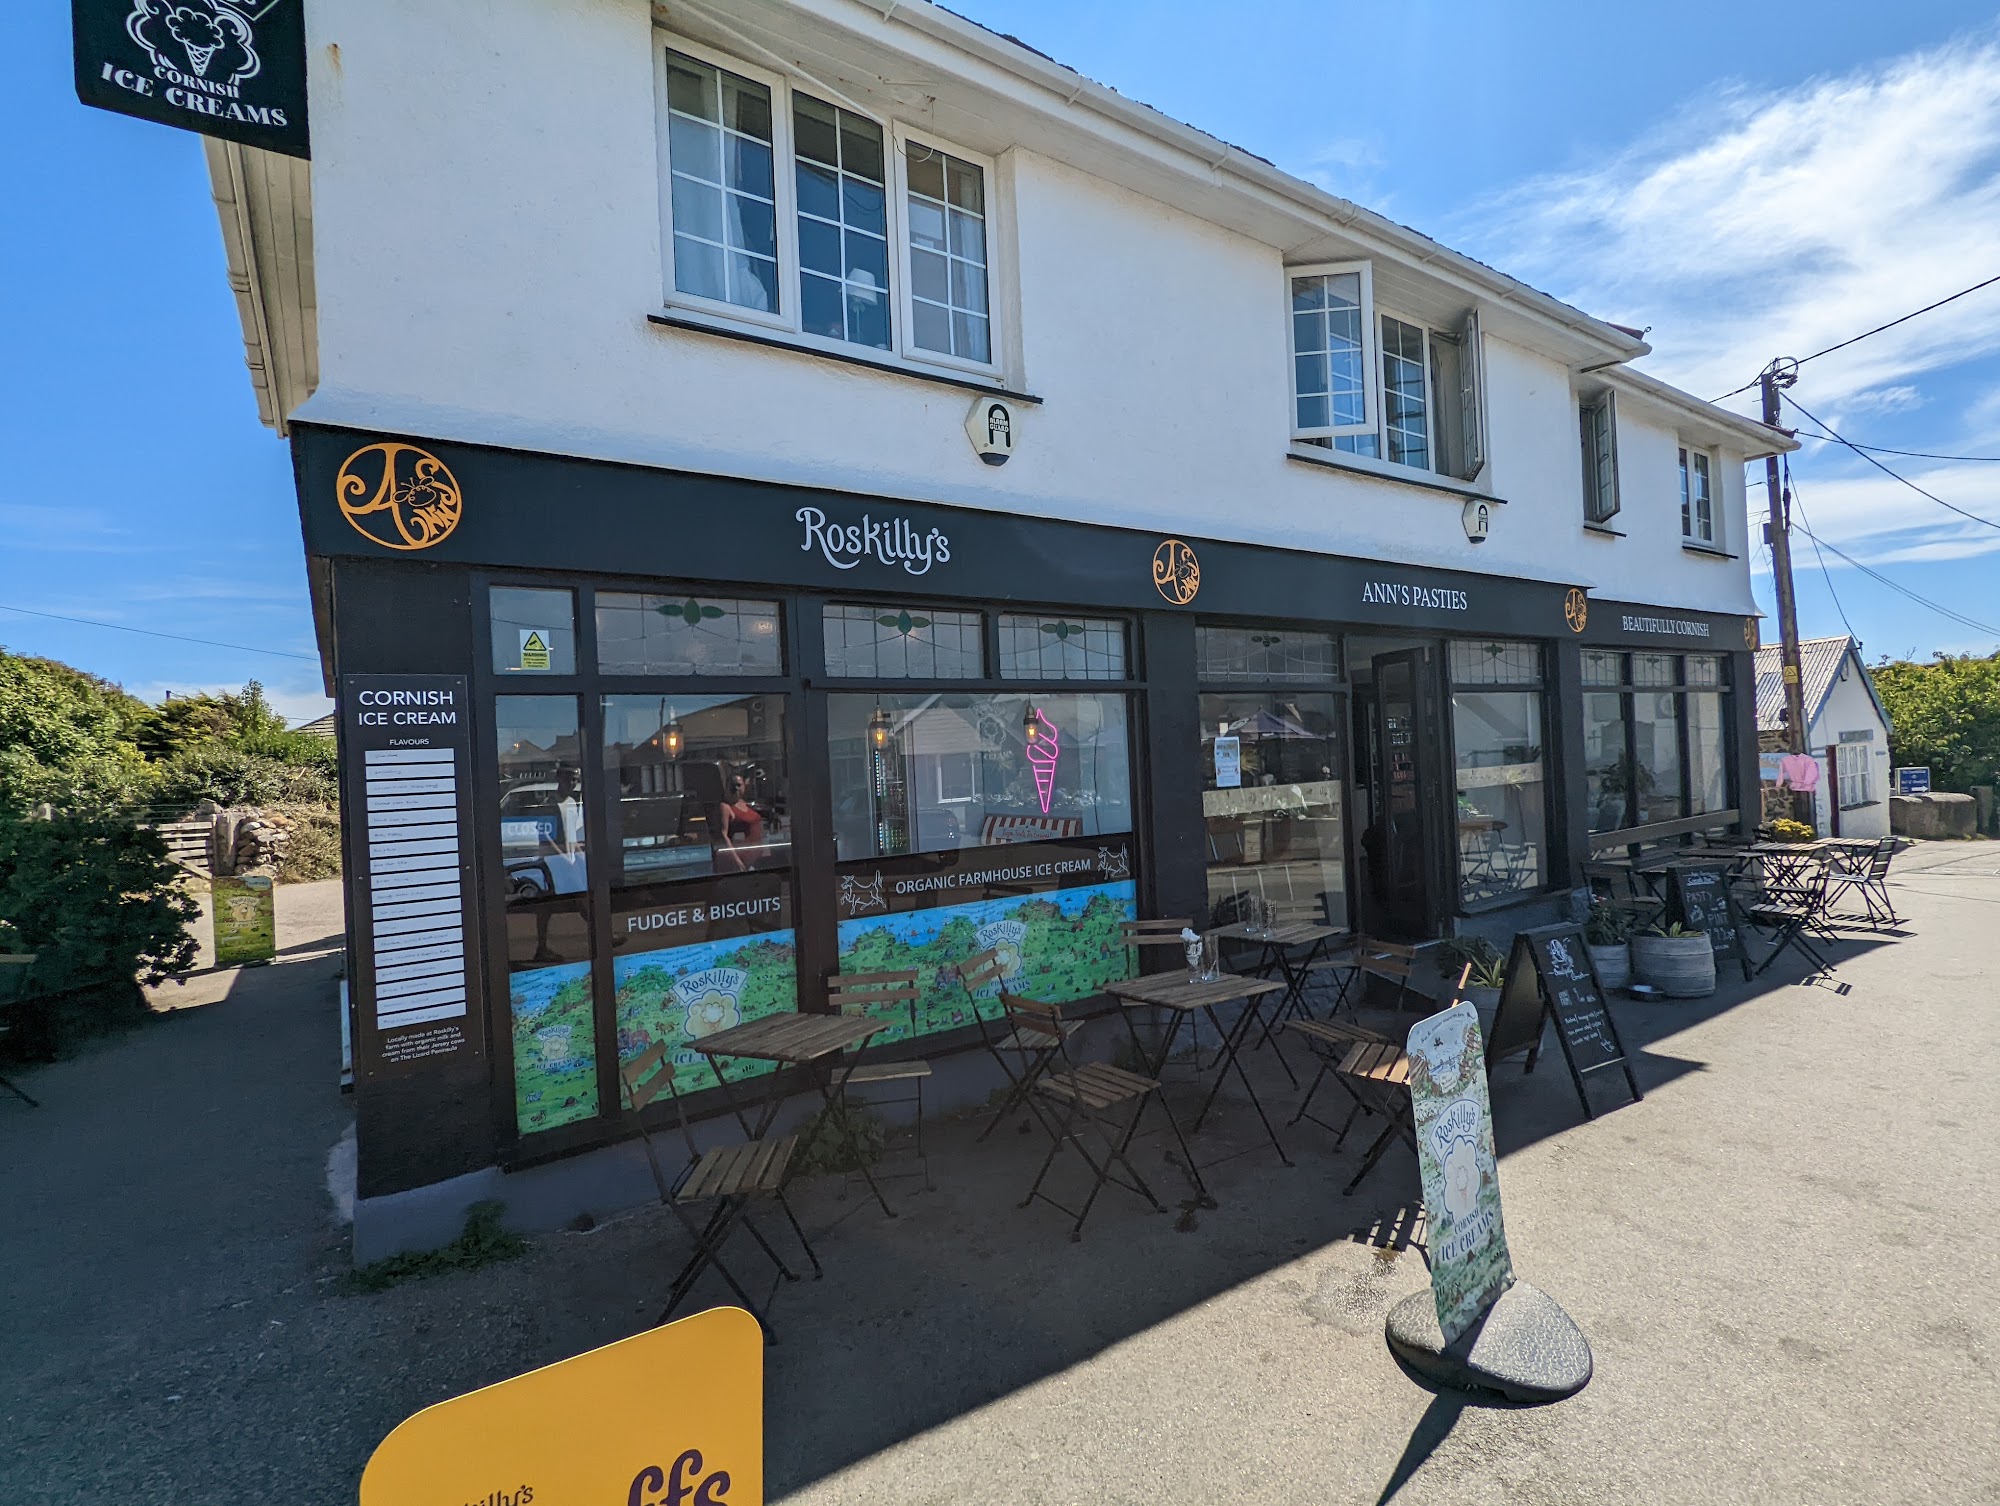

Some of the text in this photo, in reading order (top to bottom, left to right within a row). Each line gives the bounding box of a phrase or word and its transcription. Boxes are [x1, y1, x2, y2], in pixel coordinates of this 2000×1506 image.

[101, 62, 288, 127] ICE CREAMS
[154, 65, 240, 99] CORNISH
[795, 506, 951, 576] Roskilly's
[1362, 582, 1468, 610] ANN'S PASTIES
[1622, 615, 1710, 637] BEAUTIFULLY CORNISH
[359, 690, 453, 706] CORNISH
[358, 711, 457, 725] ICE CREAM
[389, 738, 430, 746] FLAVOURS
[895, 858, 1091, 895] ORGANIC FARMHOUSE ICE CREAM
[627, 896, 782, 932] FUDGE & BISCUITS
[980, 921, 1021, 942] Roskilly's
[679, 969, 740, 996] Roskilly's
[414, 1037, 436, 1045] organic
[433, 1026, 459, 1035] Roskilly's
[1435, 1103, 1476, 1149] Roskilly's
[1454, 1207, 1480, 1235] CORNISH
[1441, 1211, 1494, 1262] ICE CREAMS
